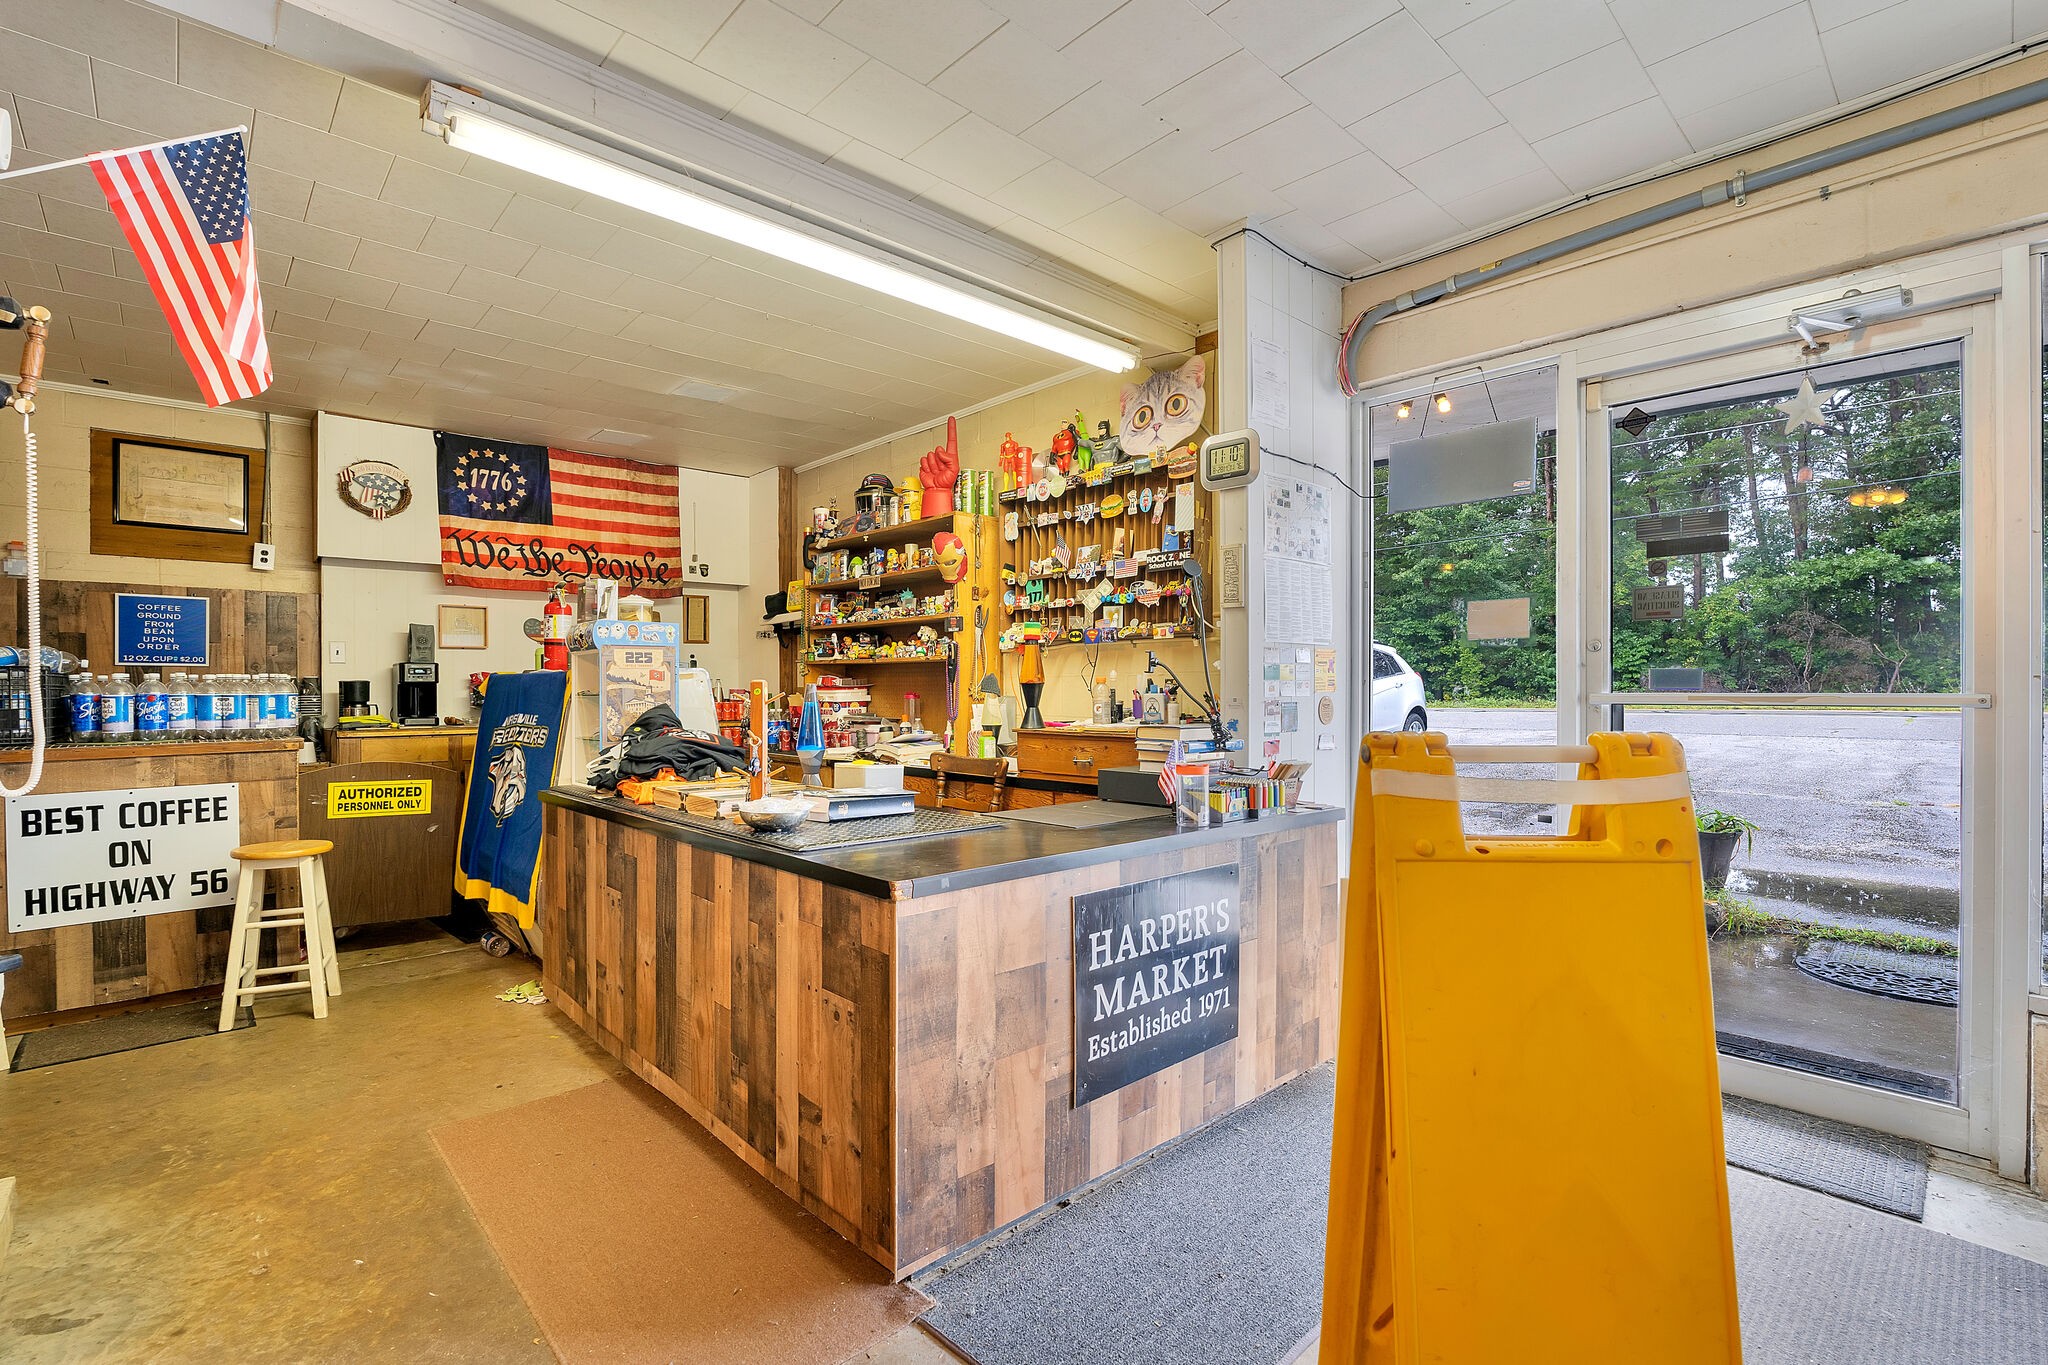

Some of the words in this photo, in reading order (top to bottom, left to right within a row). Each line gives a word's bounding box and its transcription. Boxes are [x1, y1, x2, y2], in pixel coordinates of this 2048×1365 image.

[1213, 446, 1239, 464] 11:10
[470, 467, 513, 491] 1776
[446, 528, 519, 572] We
[563, 543, 672, 592] People
[1146, 554, 1168, 564] ROCK
[1168, 551, 1191, 561] ZONE
[1148, 561, 1166, 570] School
[1112, 592, 1135, 604] 489
[137, 603, 182, 612] COFFEE
[136, 612, 182, 620] GROUND
[144, 620, 175, 628] FROM
[143, 627, 175, 635] BEAN
[137, 642, 180, 651] ORDER
[123, 654, 135, 662] 12
[625, 651, 653, 664] 225
[138, 701, 167, 717] Shasta
[338, 786, 422, 800] AUTHORIZED
[337, 800, 394, 812] PERSONNEL
[397, 799, 422, 809] ONLY
[20, 804, 104, 838] BEST
[119, 796, 229, 830] COFFEE
[109, 839, 152, 868] ON
[24, 873, 176, 917] HIGHWAY
[190, 868, 229, 897] 56
[1088, 897, 1230, 972] HARPER'S
[1093, 943, 1228, 1022] MARKET
[1087, 997, 1192, 1062] Established
[1198, 985, 1230, 1019] 1971
